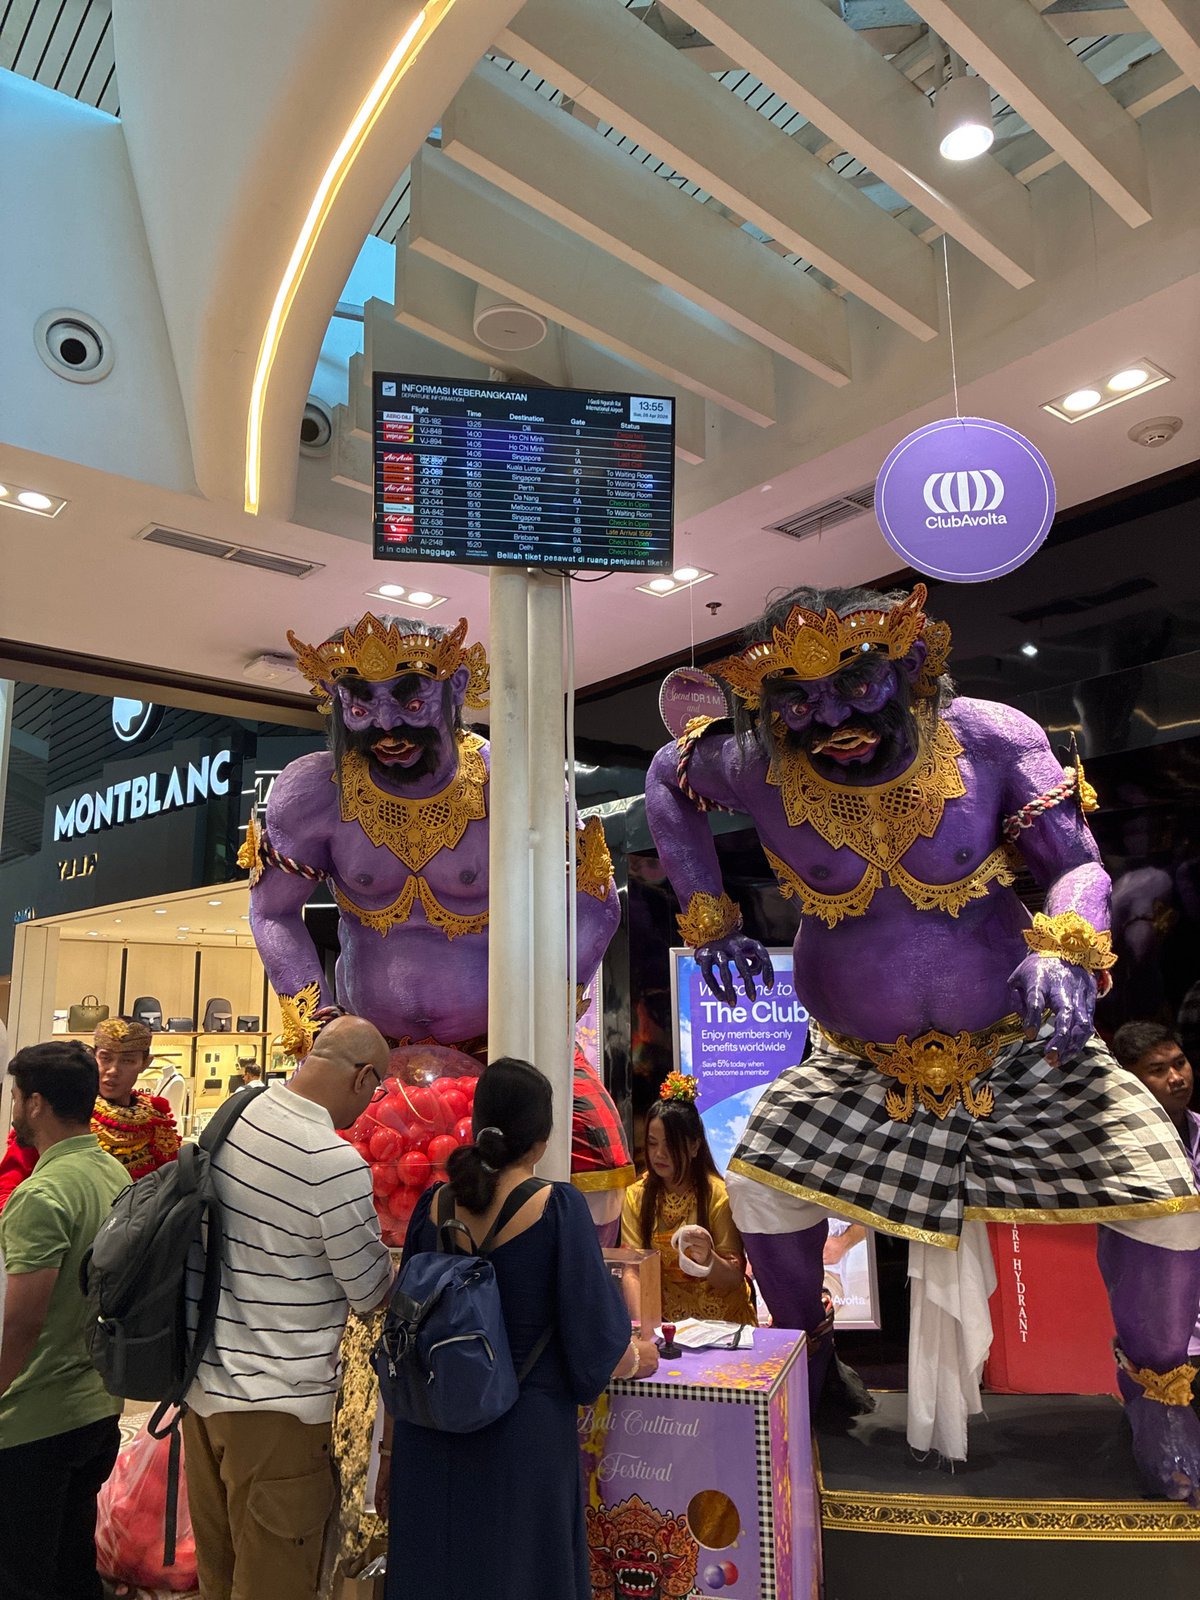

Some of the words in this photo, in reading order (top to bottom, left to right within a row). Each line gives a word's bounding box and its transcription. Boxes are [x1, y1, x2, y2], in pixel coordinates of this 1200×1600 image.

[401, 383, 450, 396] INFORMASI
[452, 389, 528, 402] KEBERANGKATAN
[411, 405, 429, 414] Flight
[639, 401, 664, 412] 13:55
[509, 413, 544, 422] Destination
[570, 418, 586, 426] Gate
[620, 422, 640, 430] Status
[511, 454, 541, 462] Singapore
[506, 463, 523, 471] Kuala
[524, 465, 546, 473] Lumpur
[615, 470, 635, 479] Waiting
[511, 474, 541, 483] Singapore
[615, 480, 635, 489] Waiting
[518, 484, 534, 492] Perth
[614, 490, 635, 499] Waiting
[523, 494, 539, 503] Nang
[634, 501, 649, 509] Open
[420, 508, 444, 516] GA-842
[511, 514, 541, 523] Singapore
[511, 504, 542, 512] Melbourne
[614, 510, 635, 518] Waiting
[925, 512, 1008, 529] ClubAvolta
[420, 548, 456, 557] baggage.
[496, 551, 523, 560] Belilah
[524, 553, 541, 561] tiket
[544, 555, 576, 564] pesawat
[578, 555, 585, 563] di
[587, 557, 608, 565] ruang
[610, 557, 645, 566] penjualan
[647, 559, 663, 567] tiket
[691, 692, 705, 703] IDR
[54, 749, 231, 842] MONTBLANC
[699, 981, 773, 996] Wcoe
[777, 981, 793, 996] to
[700, 1002, 747, 1023] The
[752, 1002, 809, 1023] Club
[702, 1030, 726, 1041] Enjoy
[728, 1030, 792, 1040] members-only
[702, 1042, 738, 1052] benefits
[738, 1042, 786, 1052] worldwide
[717, 1060, 730, 1068] 5%
[702, 1070, 714, 1078] you
[1013, 1258, 1028, 1342] HYDRANT
[577, 1405, 617, 1434] Bali
[622, 1409, 700, 1437] Cultural
[597, 1452, 674, 1483] Festival
